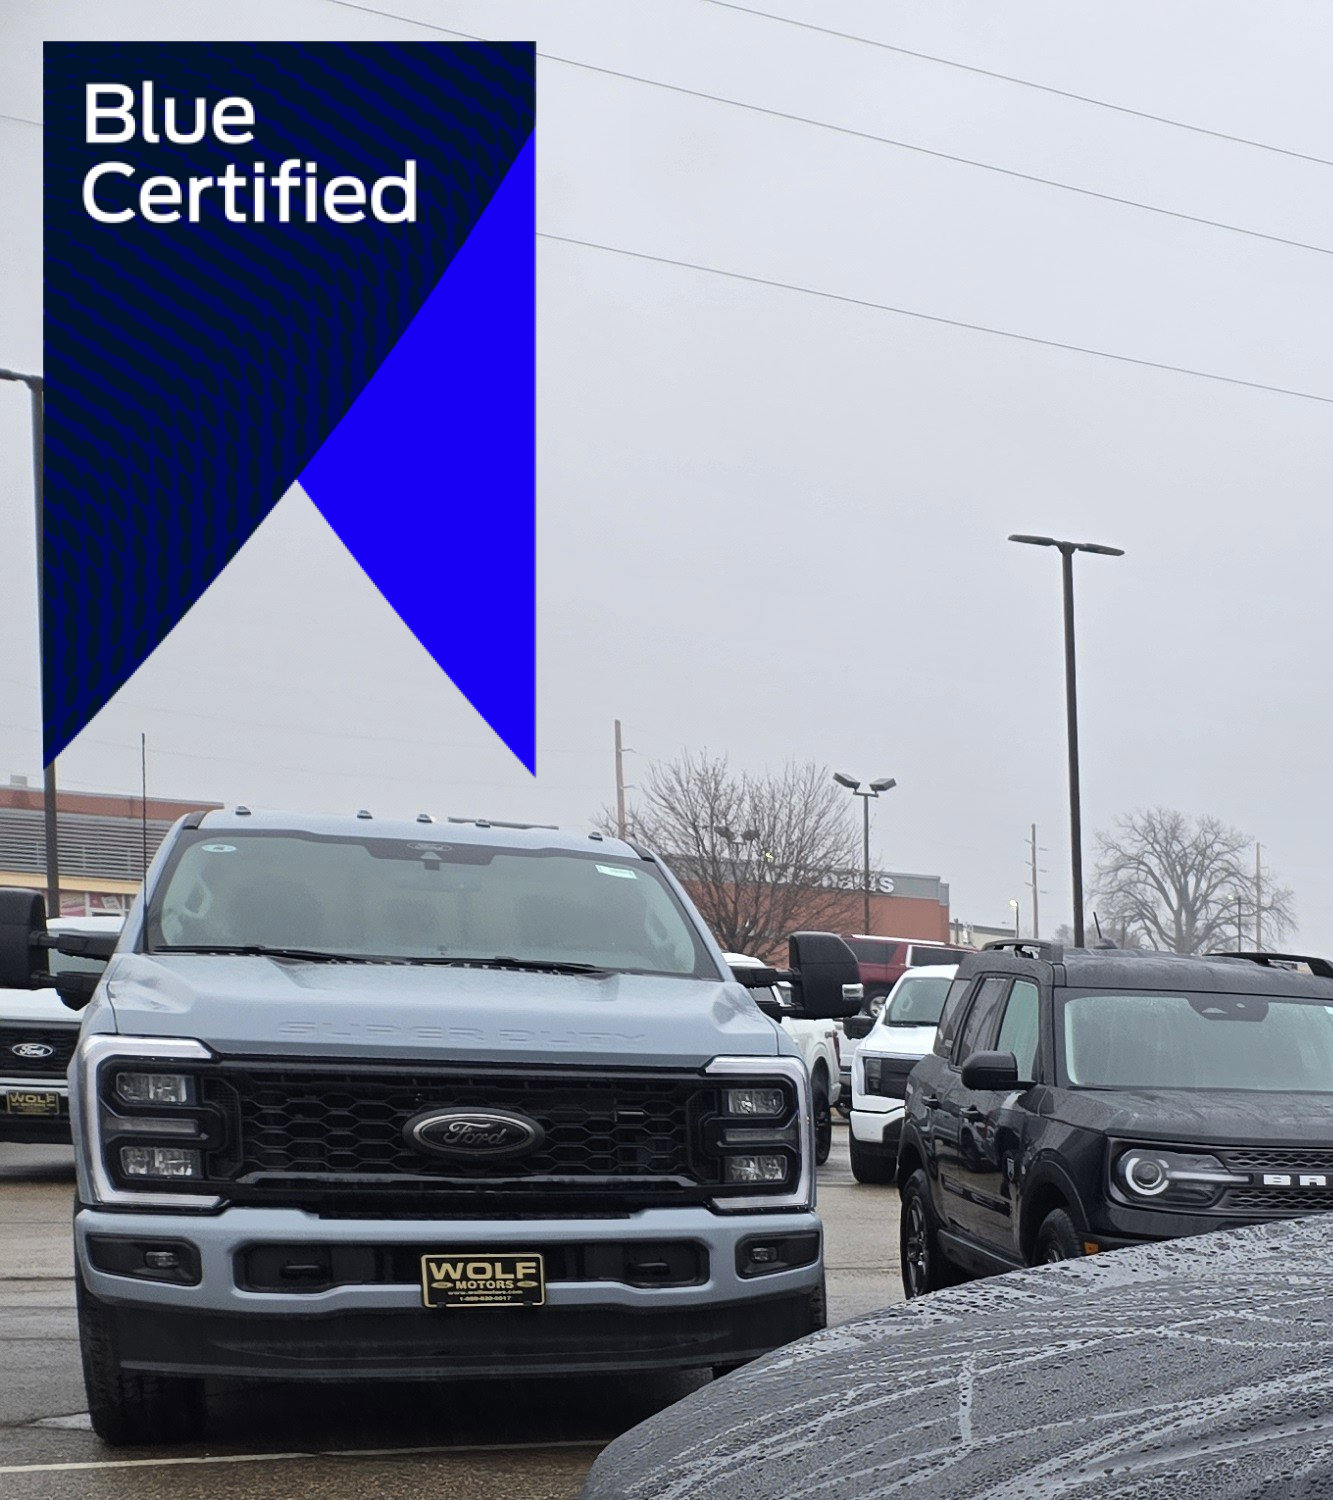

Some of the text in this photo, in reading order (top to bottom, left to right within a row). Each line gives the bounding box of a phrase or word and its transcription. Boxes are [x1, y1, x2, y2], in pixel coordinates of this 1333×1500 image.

[278, 1020, 645, 1043] SUPER DUTY
[10, 1093, 56, 1103] WOLF
[442, 1121, 508, 1145] Ford
[429, 1262, 537, 1280] WOLF
[455, 1280, 515, 1290] MOTORS
